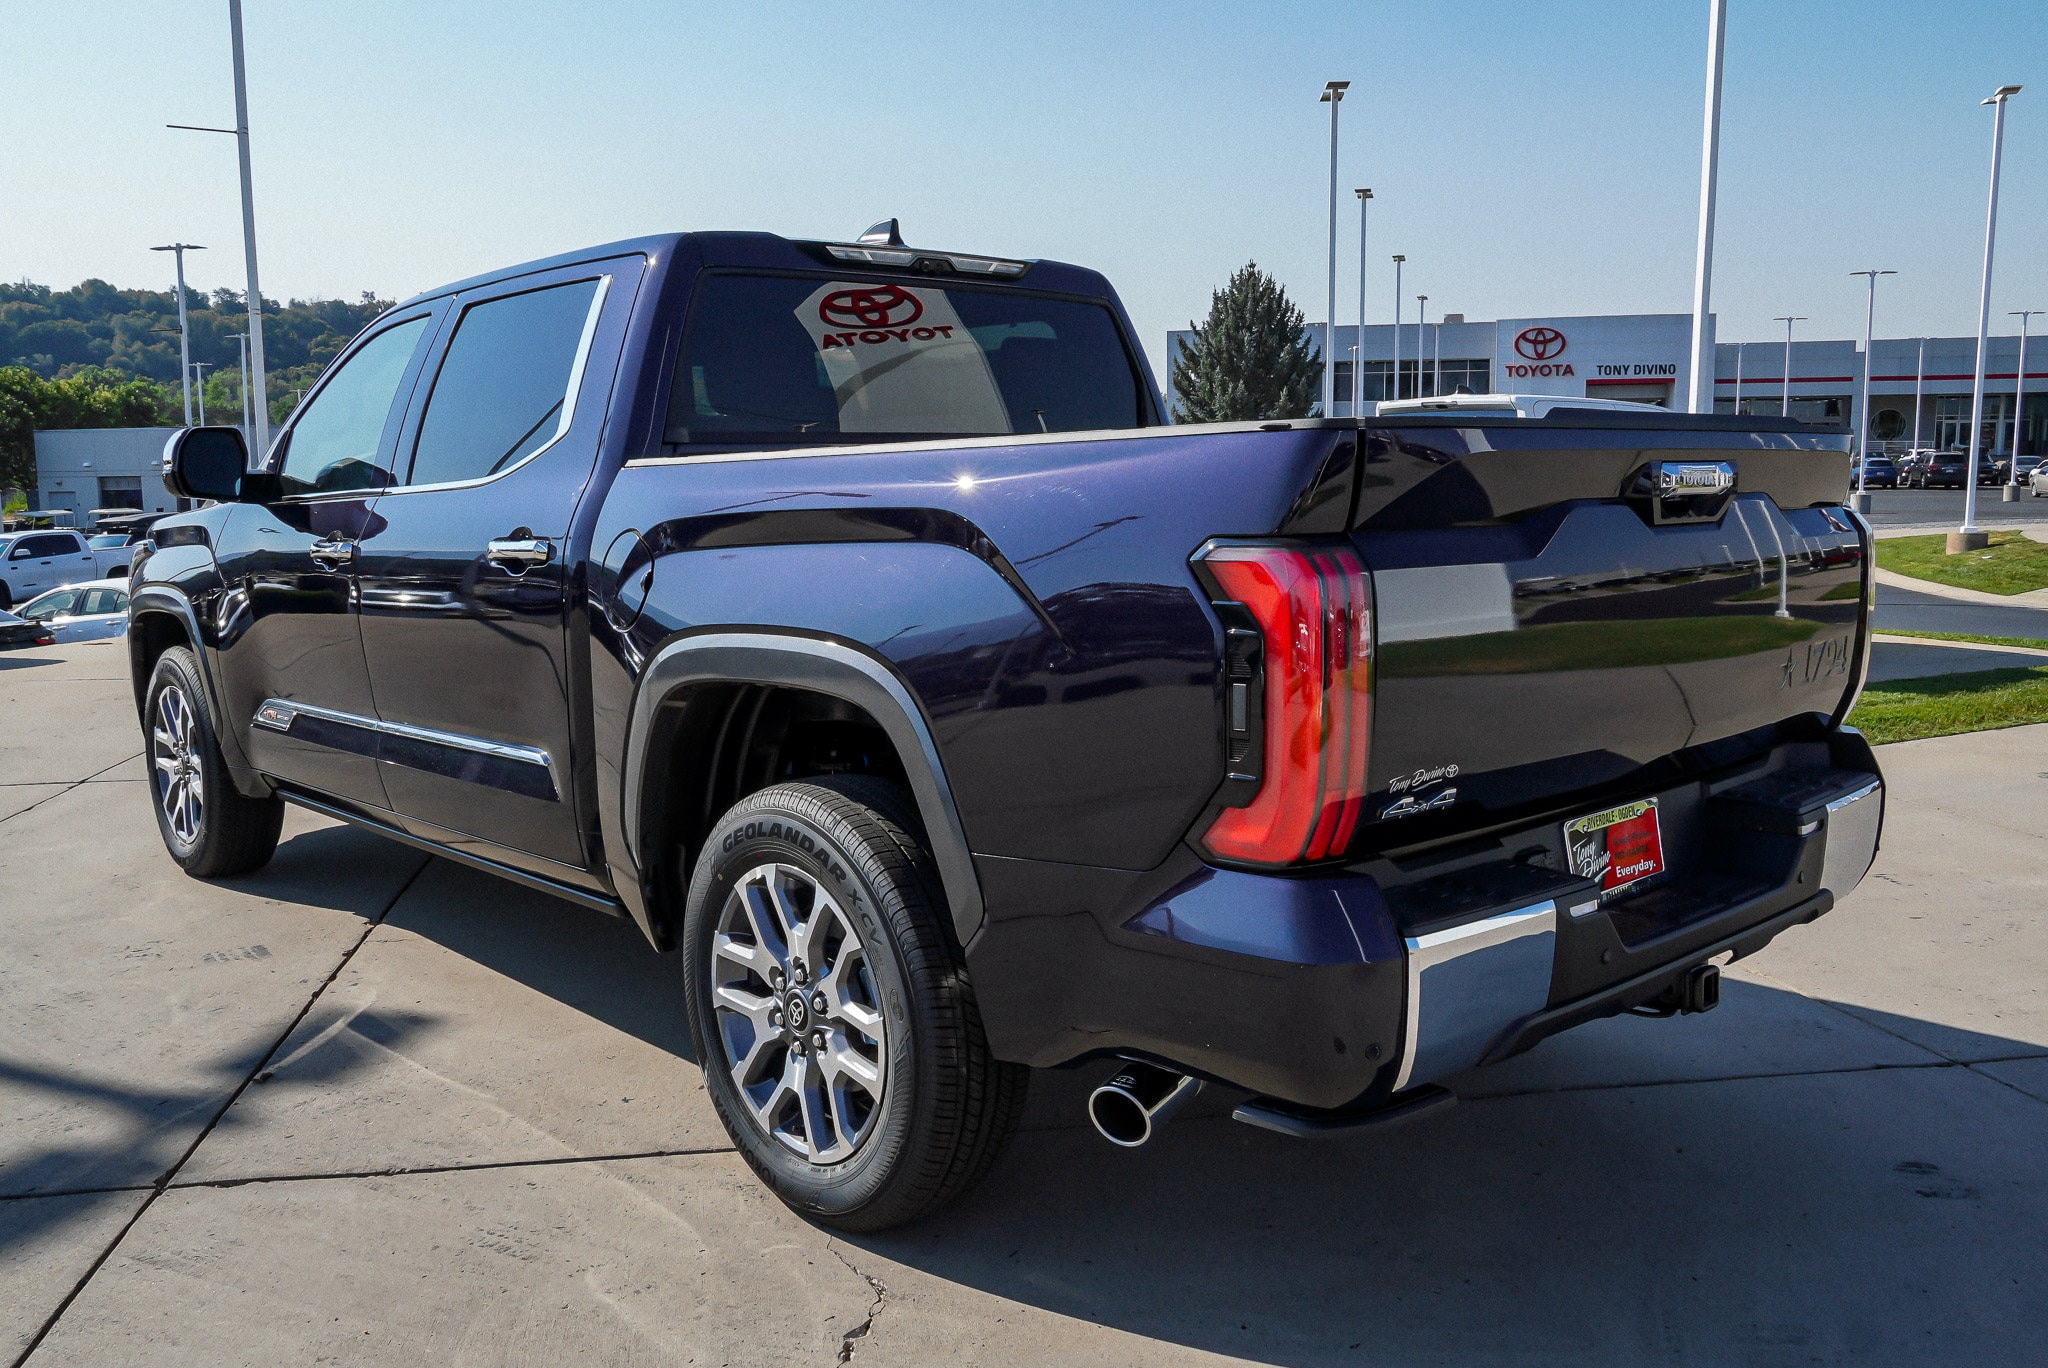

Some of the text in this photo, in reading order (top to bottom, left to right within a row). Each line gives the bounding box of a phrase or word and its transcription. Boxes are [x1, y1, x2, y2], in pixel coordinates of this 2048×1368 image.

[1504, 364, 1574, 378] TOYOTA
[1596, 363, 1677, 376] TONY DIVINO
[1804, 635, 1849, 683] 1794
[1388, 774, 1412, 794] Tony
[1586, 810, 1616, 830] RIVERDALE
[1572, 837, 1597, 865] Tony
[1578, 850, 1612, 879] Divino
[1615, 859, 1657, 878] Everyday.
[722, 821, 883, 946] GEOLANDAR X-CV
